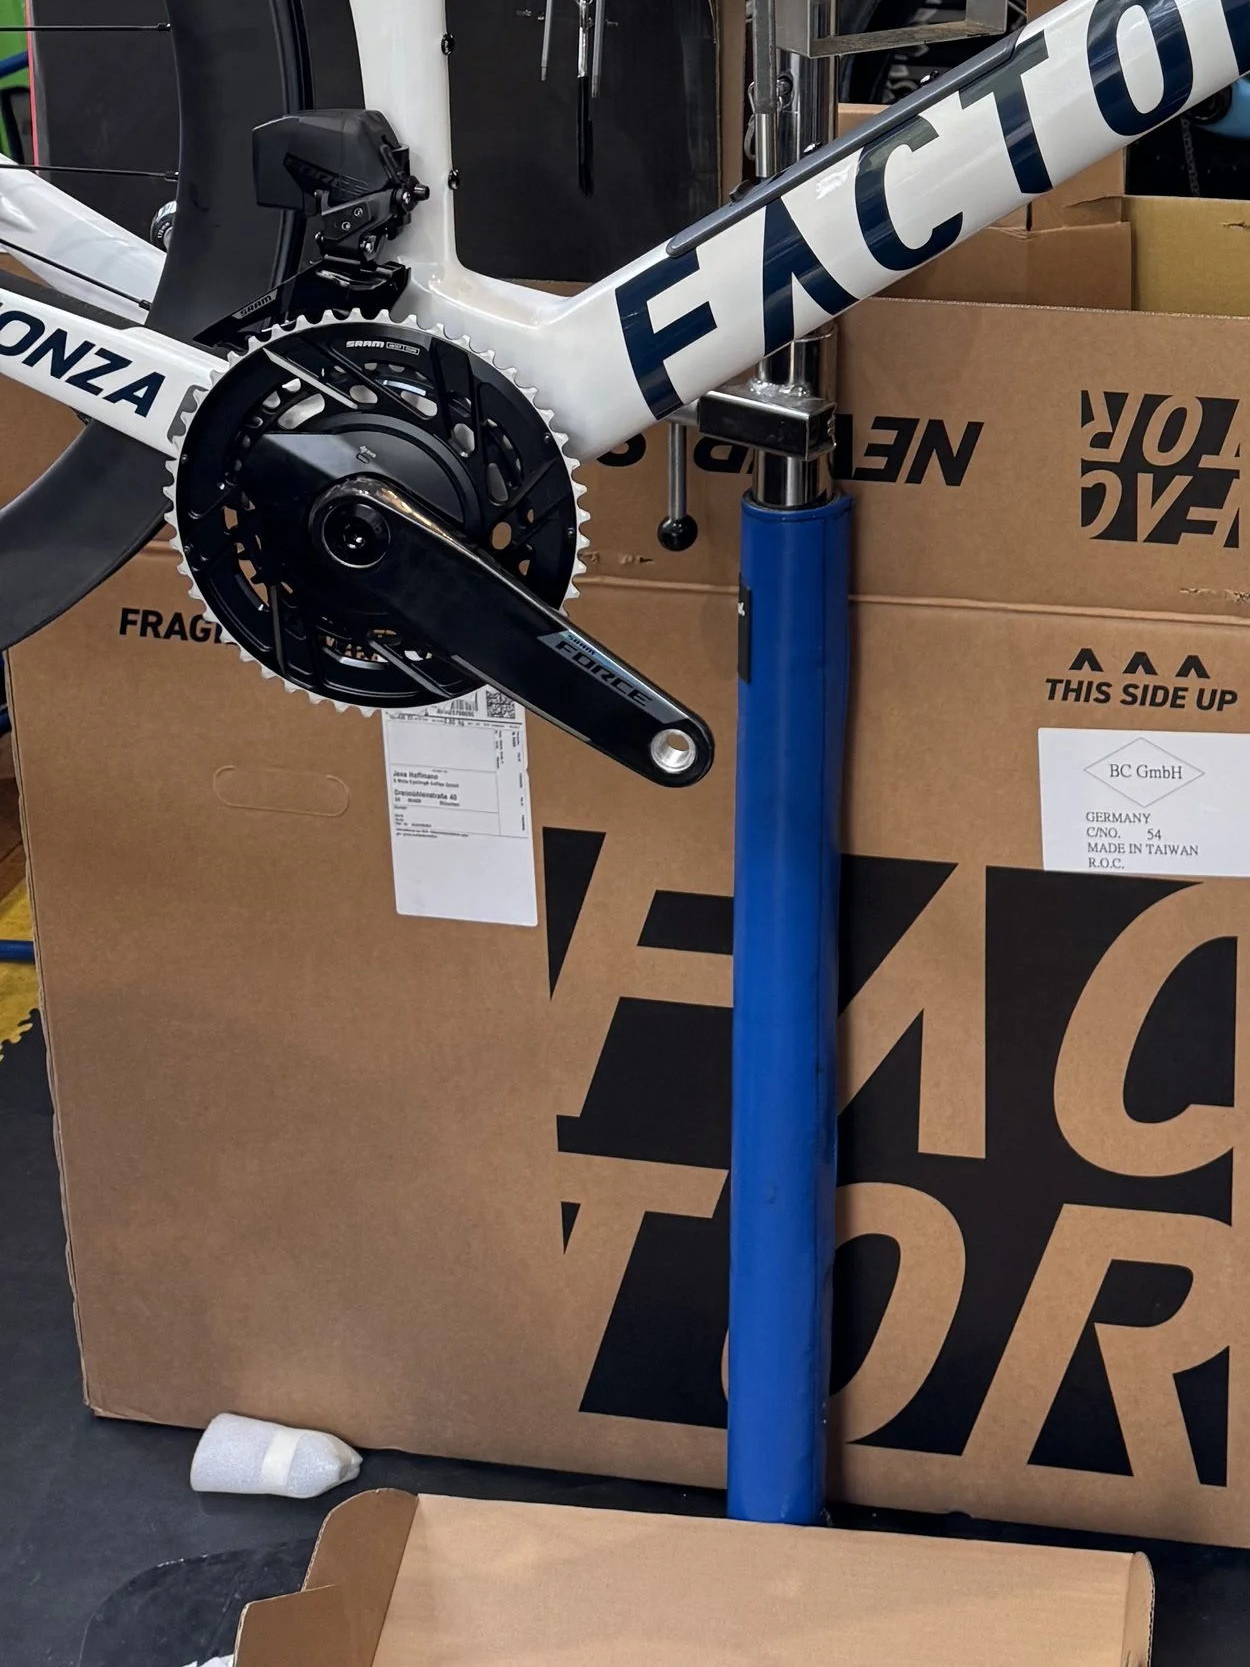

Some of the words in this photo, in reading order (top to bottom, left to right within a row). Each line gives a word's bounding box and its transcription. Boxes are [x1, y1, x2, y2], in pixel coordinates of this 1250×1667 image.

[239, 294, 273, 317] SRAM
[346, 340, 385, 348] SRAM
[0, 304, 166, 418] ONZA
[555, 640, 655, 707] FORCE
[1045, 678, 1112, 704] THIS
[1120, 683, 1188, 709] SIDE
[1196, 688, 1238, 711] UP
[1109, 763, 1132, 779] BC
[1136, 764, 1182, 779] GmbH
[1086, 811, 1151, 824] GERMANY
[1086, 827, 1121, 838] C/NO.
[1147, 829, 1161, 840] 54
[1087, 842, 1126, 853] MADE
[1129, 843, 1143, 854] IN
[1145, 844, 1199, 855] TAIWAN
[1088, 857, 1125, 870] R.O.C.
